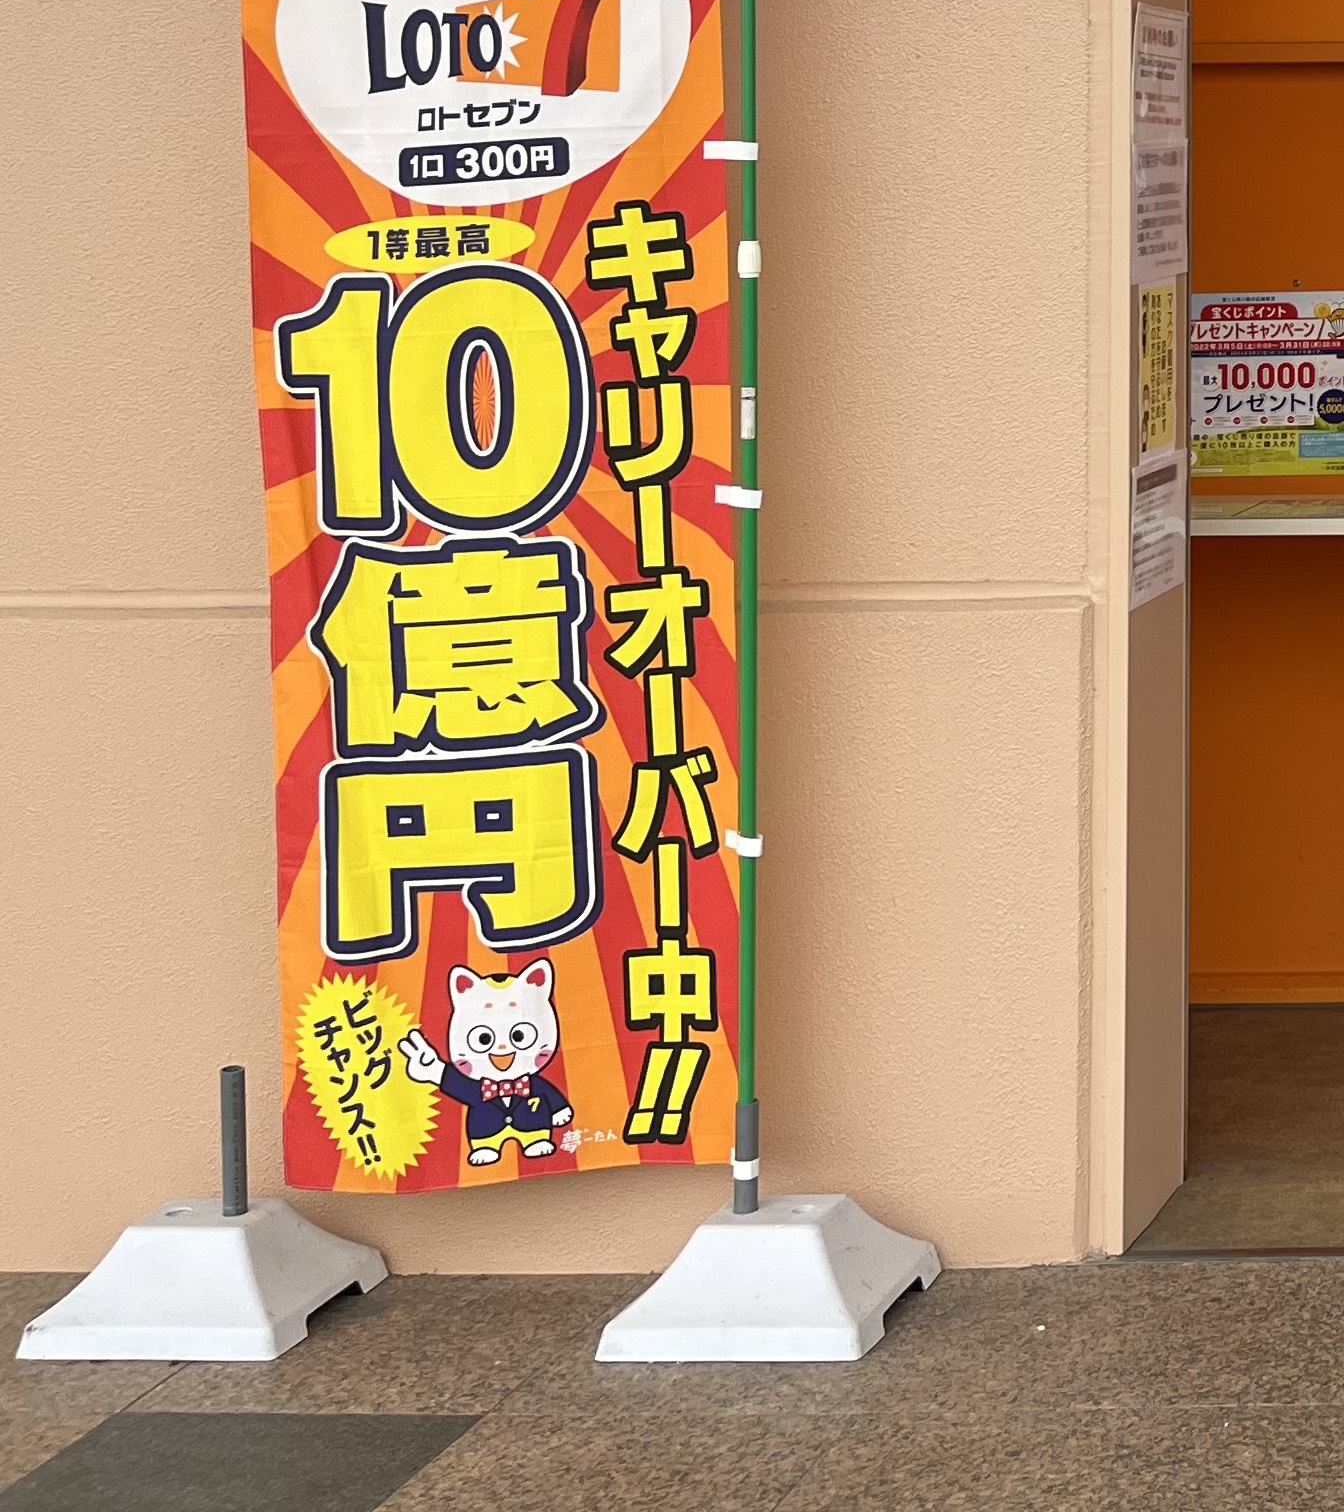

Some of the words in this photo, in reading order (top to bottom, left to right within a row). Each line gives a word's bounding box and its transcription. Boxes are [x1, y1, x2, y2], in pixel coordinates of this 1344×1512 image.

[362, 1, 503, 95] LOTO
[417, 99, 542, 132] ロトセブン
[455, 144, 556, 178] 300円
[367, 224, 491, 261] 1等最高
[1211, 305, 1287, 319] 宝くじポイント
[1218, 361, 1317, 390] 10,000
[1203, 393, 1315, 415] プレゼント!
[284, 271, 592, 954] 10億円
[343, 990, 393, 1090] ビッグ
